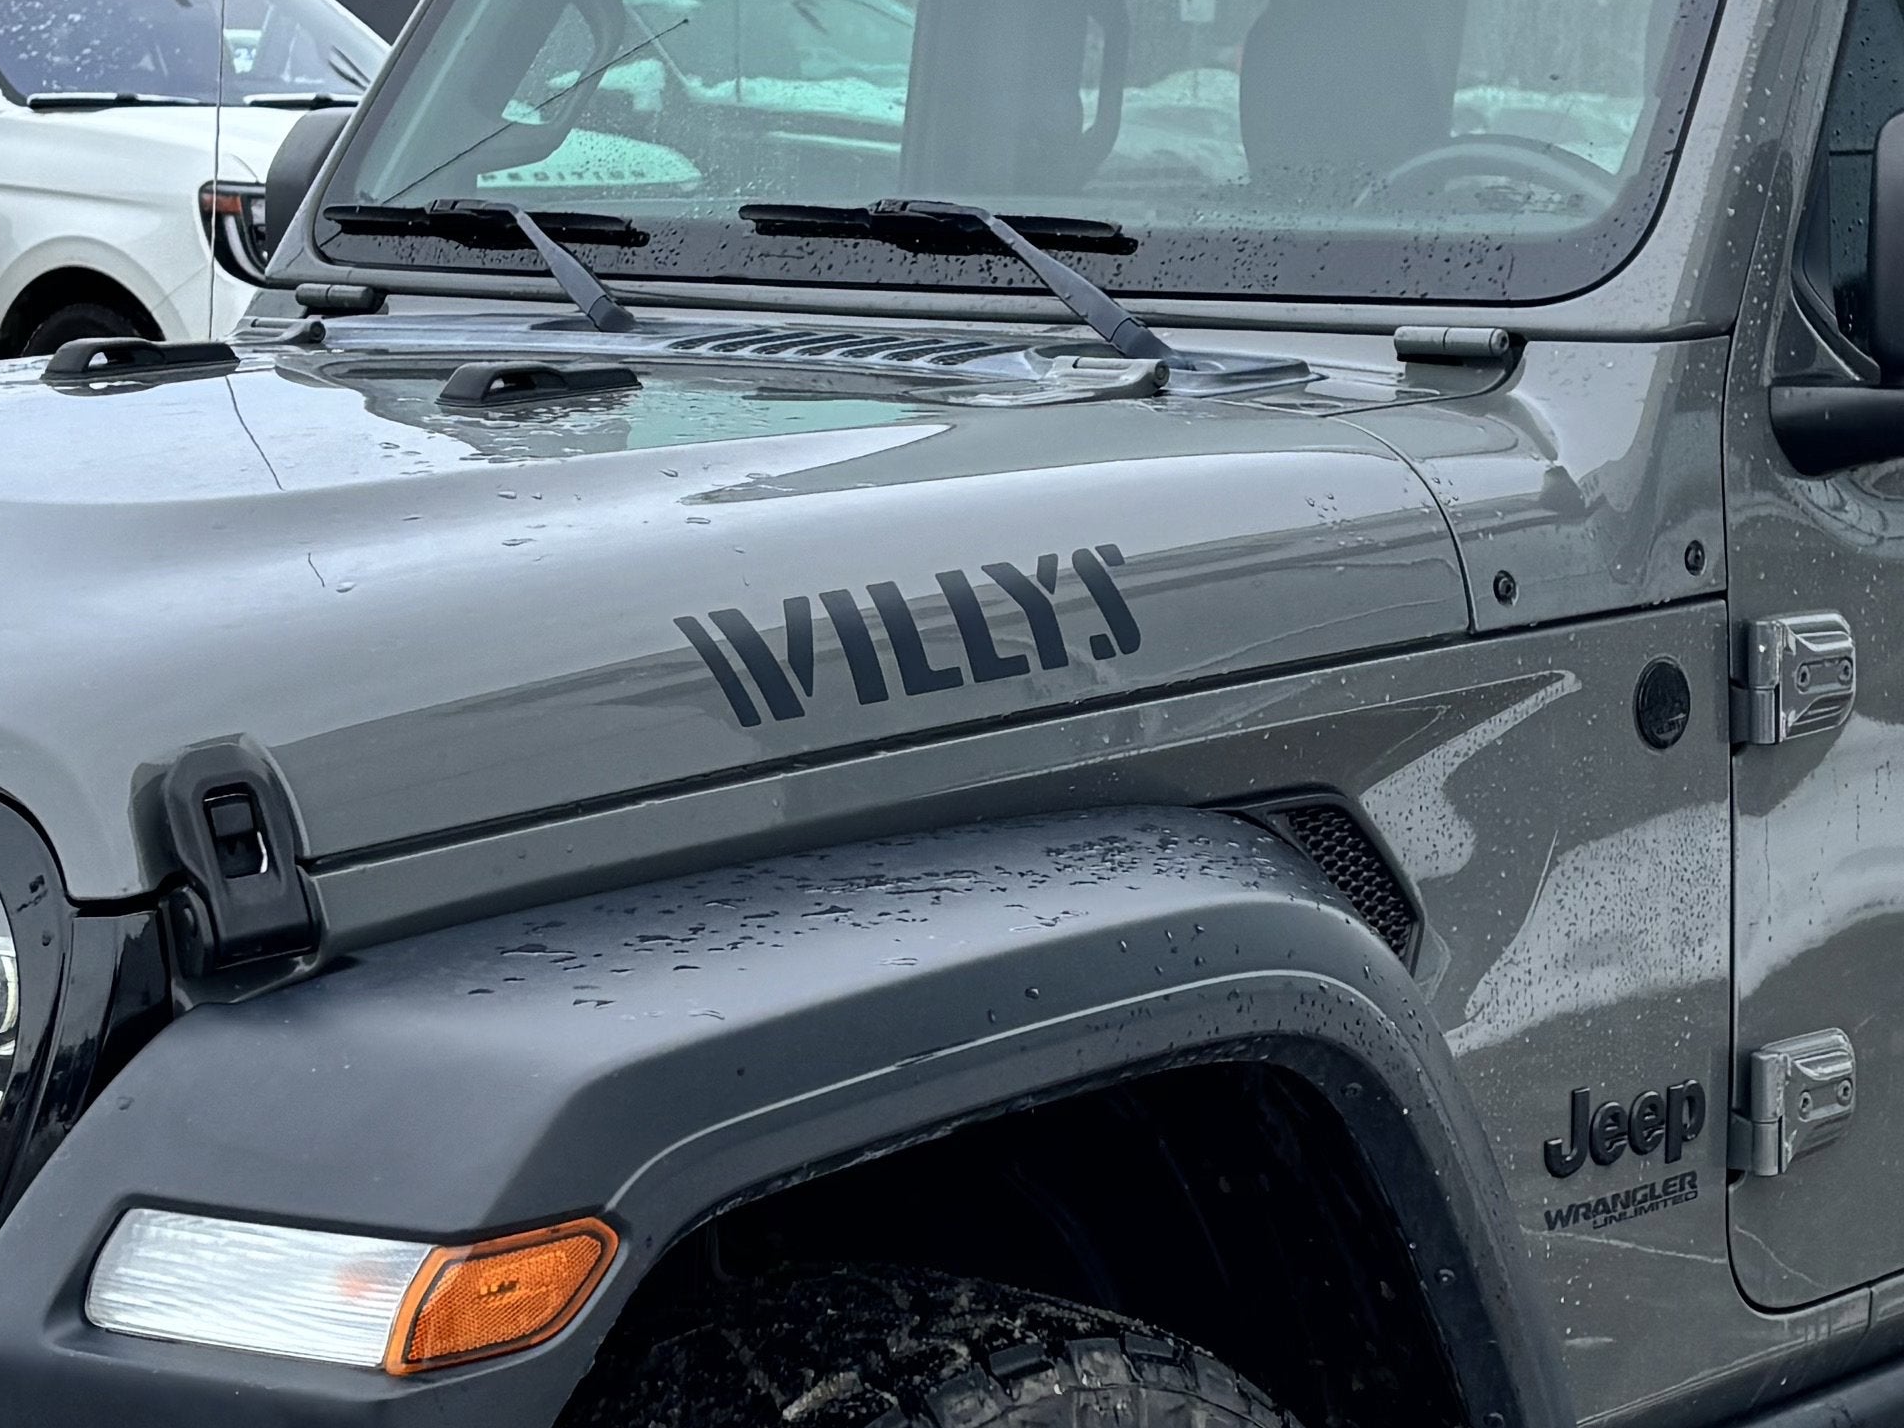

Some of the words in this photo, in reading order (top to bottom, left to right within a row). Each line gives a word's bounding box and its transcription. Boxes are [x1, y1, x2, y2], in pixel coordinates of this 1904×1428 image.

[672, 543, 1142, 728] WILLYS
[1543, 1079, 1706, 1179] Jeep
[1544, 1170, 1698, 1231] WRANGLER
[1592, 1190, 1699, 1230] UNLIMITED
